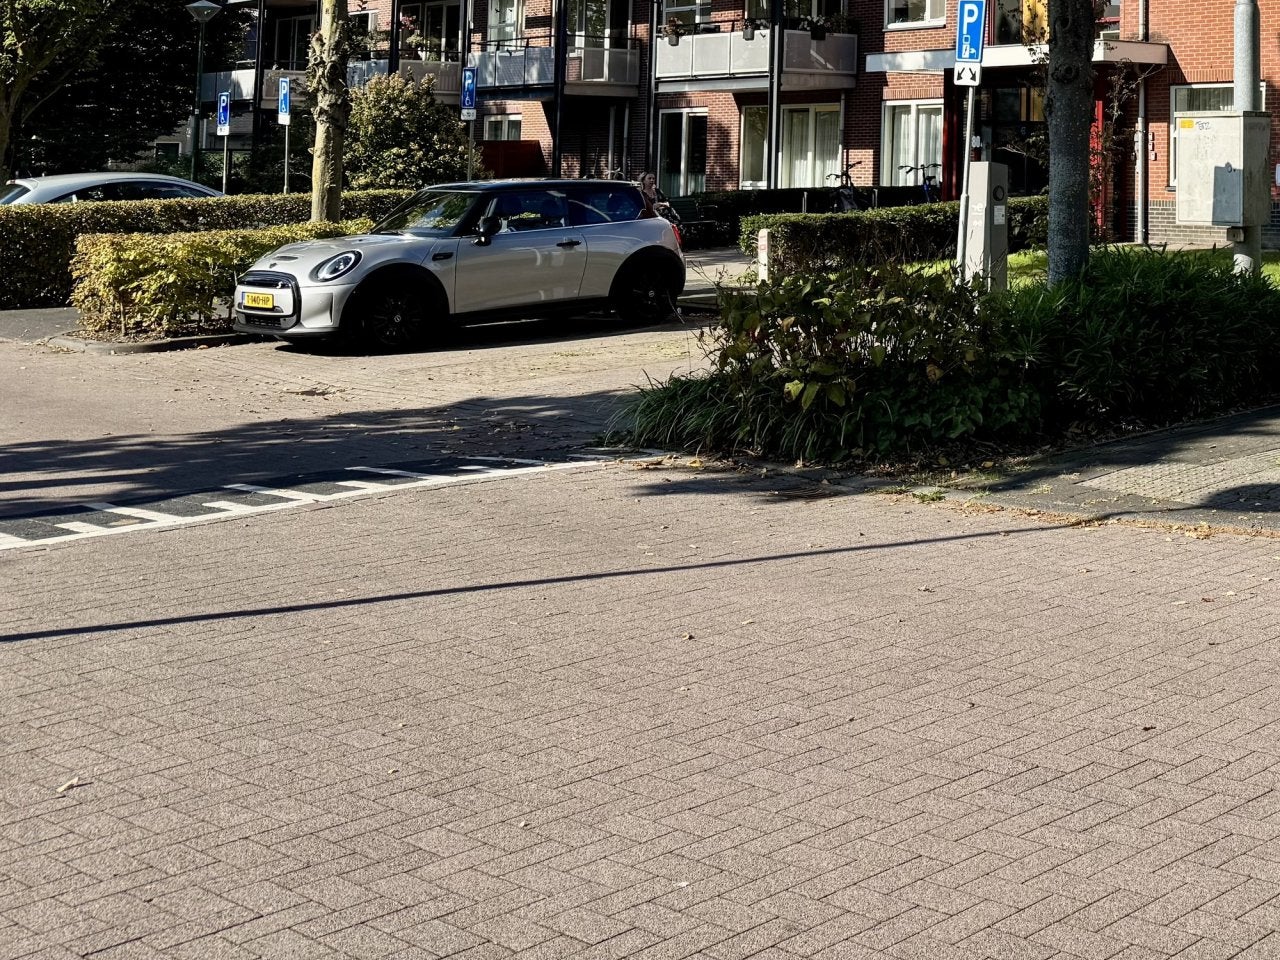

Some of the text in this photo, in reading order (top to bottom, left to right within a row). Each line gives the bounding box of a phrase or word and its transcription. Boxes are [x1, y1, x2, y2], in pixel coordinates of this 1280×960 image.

[963, 3, 979, 35] P
[465, 70, 473, 91] P
[281, 82, 287, 99] P
[220, 96, 227, 113] P
